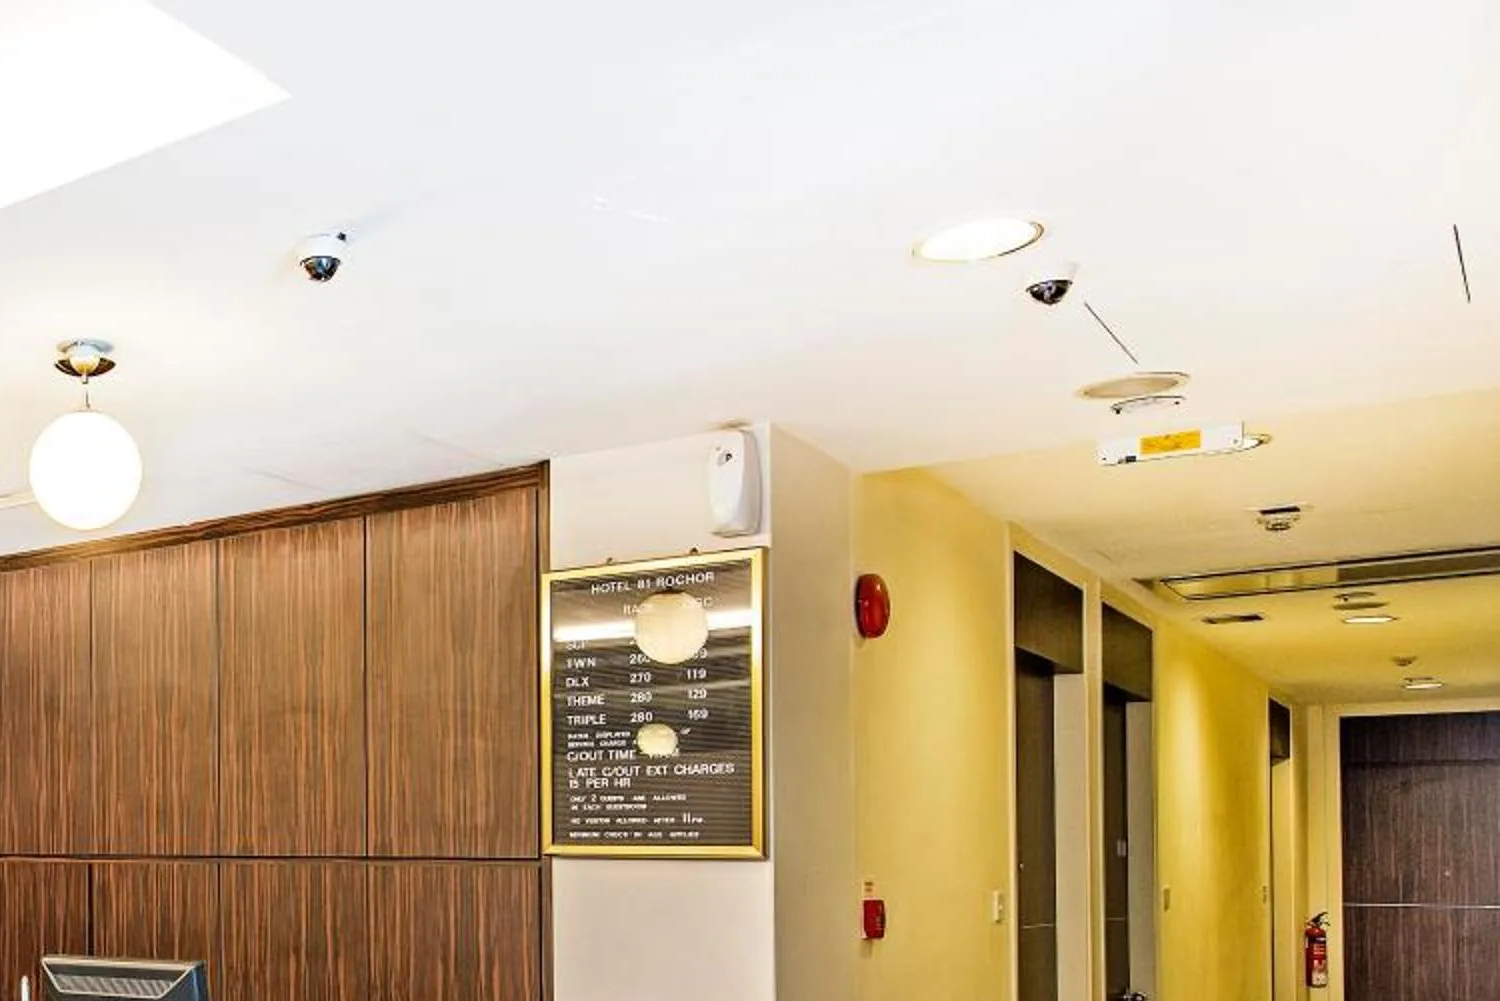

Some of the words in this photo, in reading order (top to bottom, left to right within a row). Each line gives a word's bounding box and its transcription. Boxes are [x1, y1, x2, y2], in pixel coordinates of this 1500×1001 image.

[591, 581, 631, 595] HOTEL
[655, 571, 715, 589] ROCHOR
[567, 657, 596, 669] TWN
[565, 676, 589, 688] DLX
[629, 671, 652, 684] 270
[686, 668, 707, 680] 119
[567, 694, 605, 707] THEME
[566, 713, 606, 726] TRIPLE
[630, 711, 653, 723] 280
[608, 749, 638, 761] TIME
[569, 766, 597, 778] LATE
[602, 765, 641, 777] C/OUT
[646, 764, 669, 776] EXT
[674, 762, 735, 775] CHARGES
[586, 777, 609, 788] PER
[614, 777, 631, 788] HR
